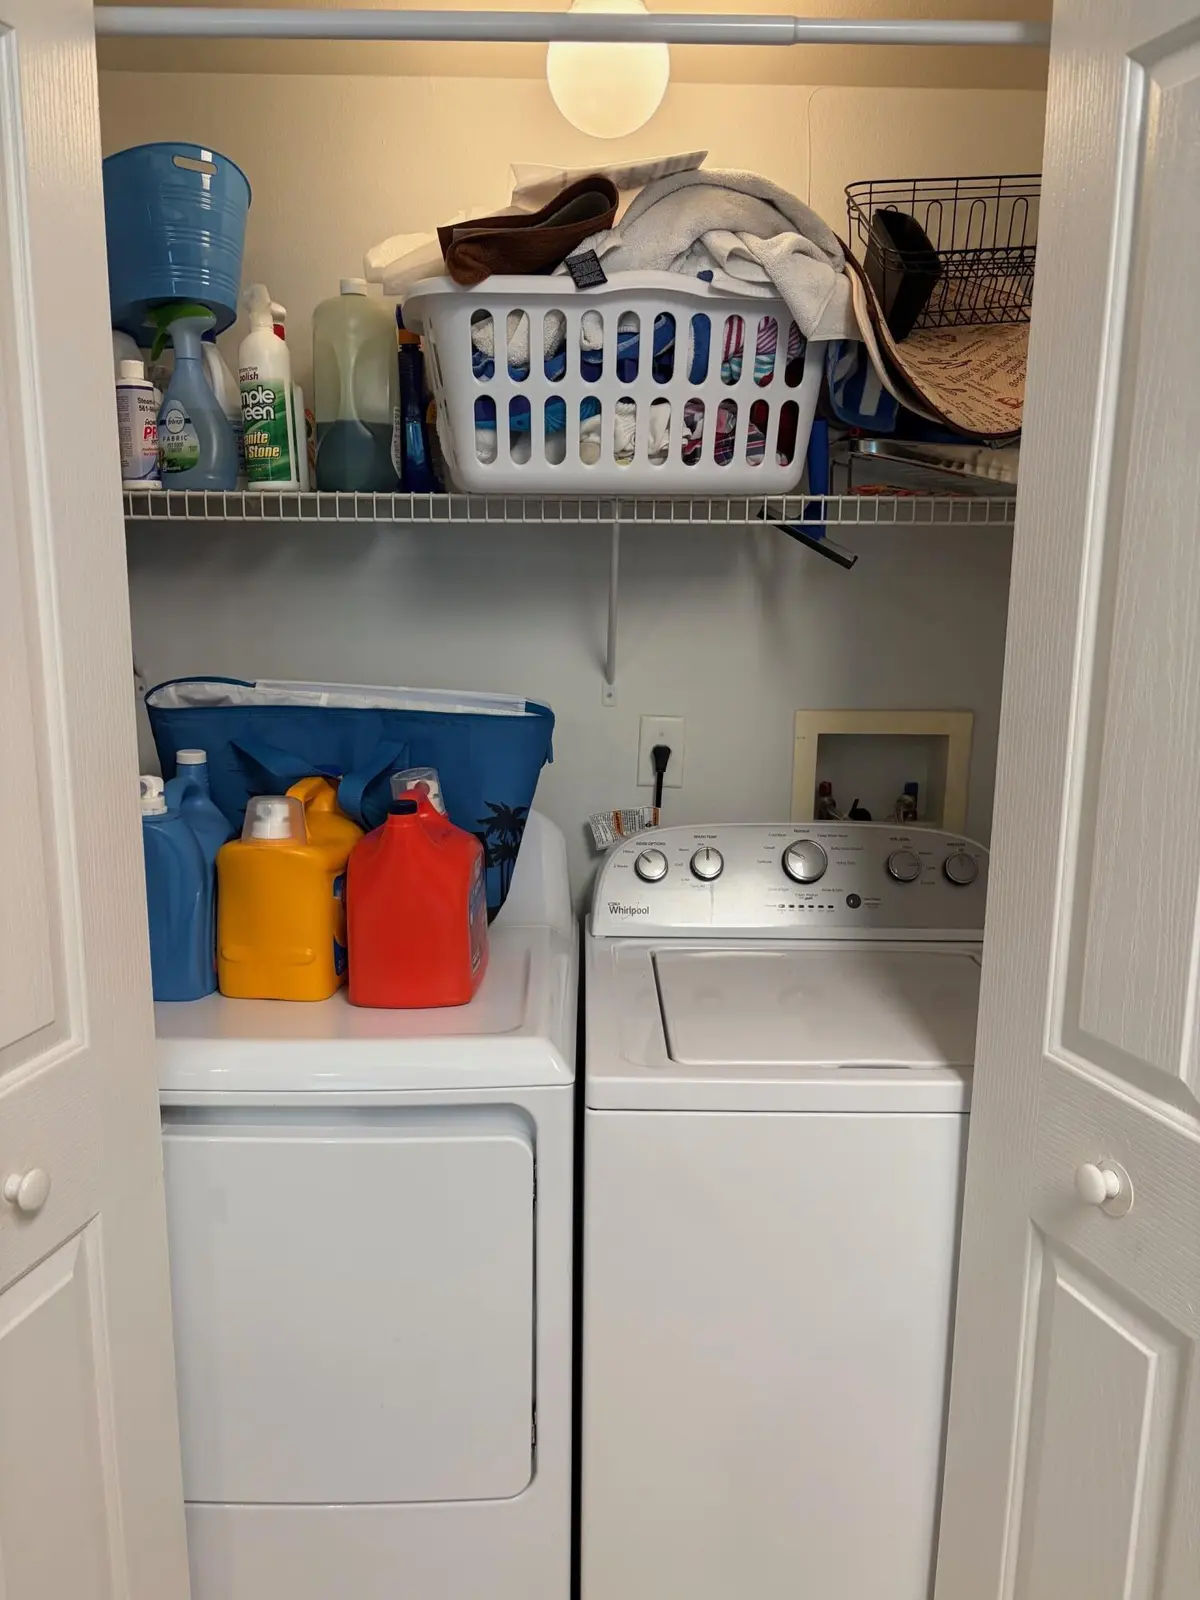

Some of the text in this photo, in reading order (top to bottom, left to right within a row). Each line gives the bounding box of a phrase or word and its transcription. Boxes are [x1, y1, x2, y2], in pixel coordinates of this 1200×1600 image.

[162, 434, 188, 442] FABRIC
[248, 445, 280, 459] Stone
[608, 905, 650, 917] Whirlpool
